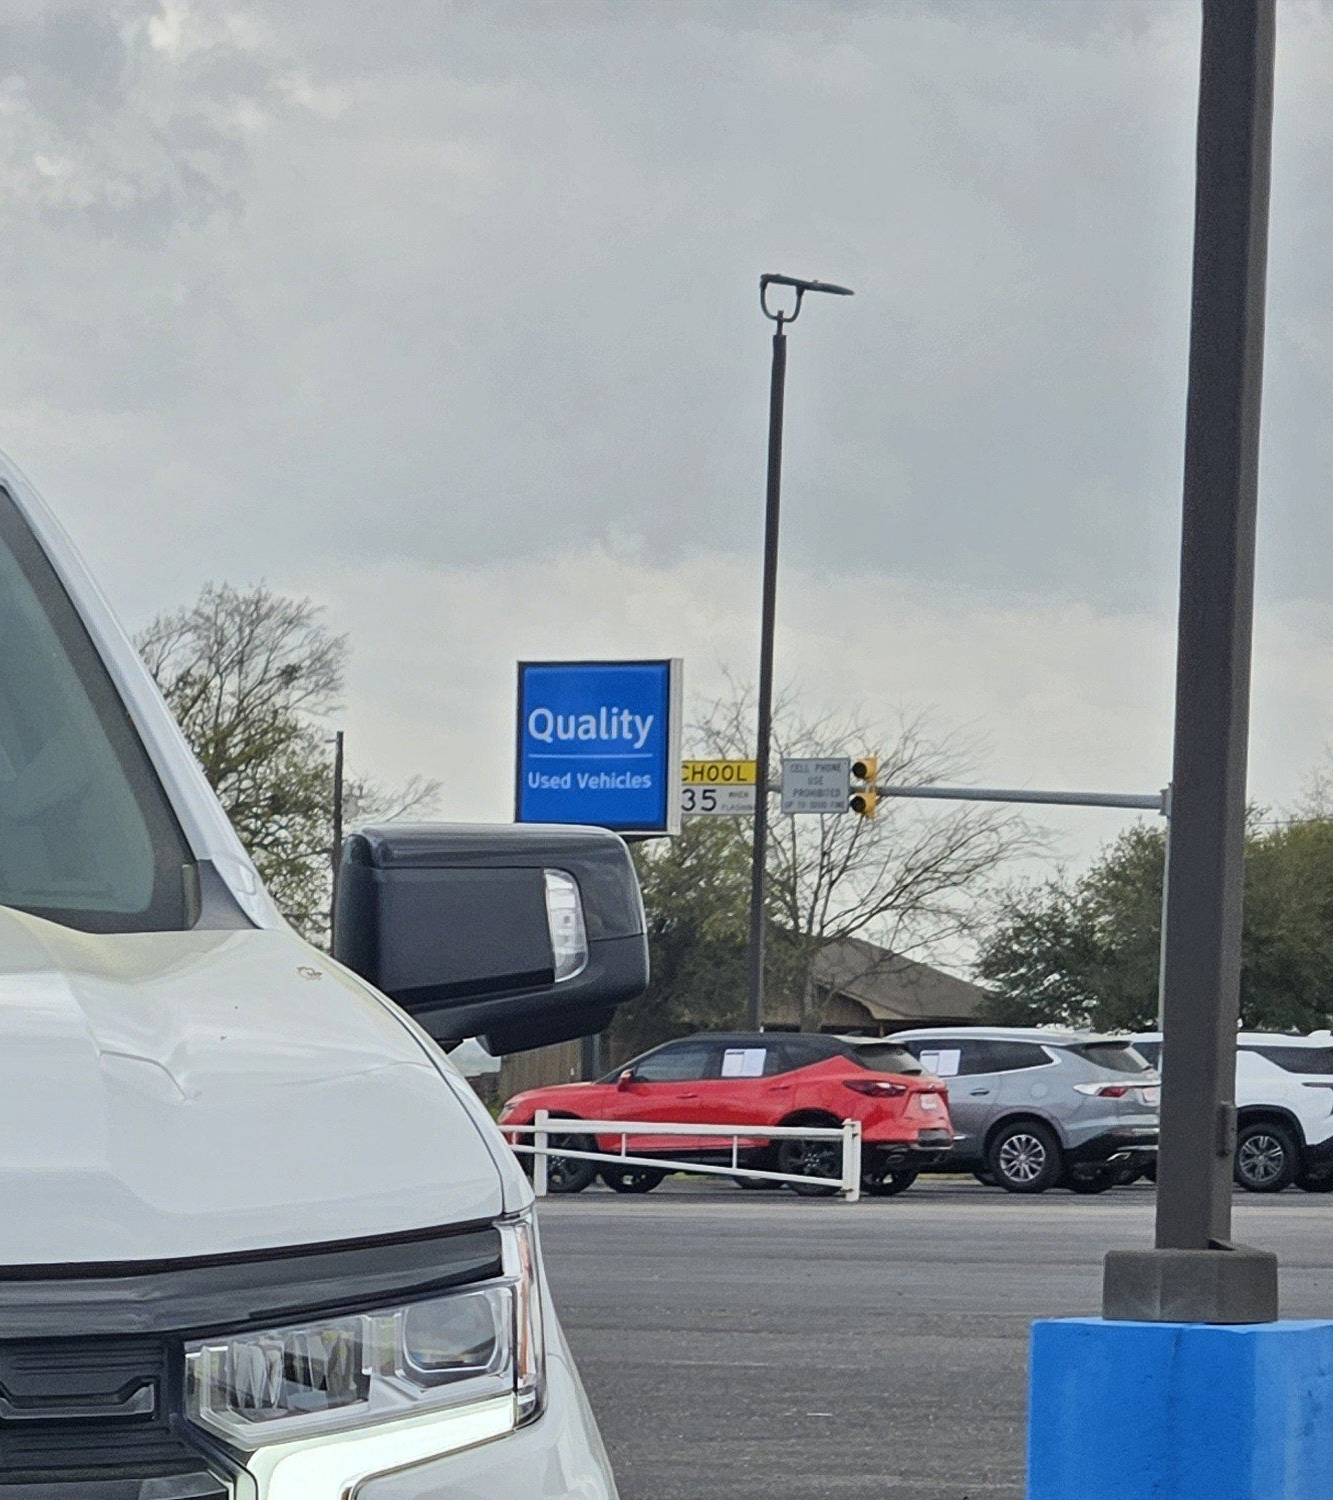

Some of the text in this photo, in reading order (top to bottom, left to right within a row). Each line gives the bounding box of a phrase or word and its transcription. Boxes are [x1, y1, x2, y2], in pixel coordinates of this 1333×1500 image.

[528, 706, 654, 749] Quality
[528, 771, 652, 789] Used Vehicles
[681, 765, 747, 782] CHOOL
[681, 788, 717, 811] 35
